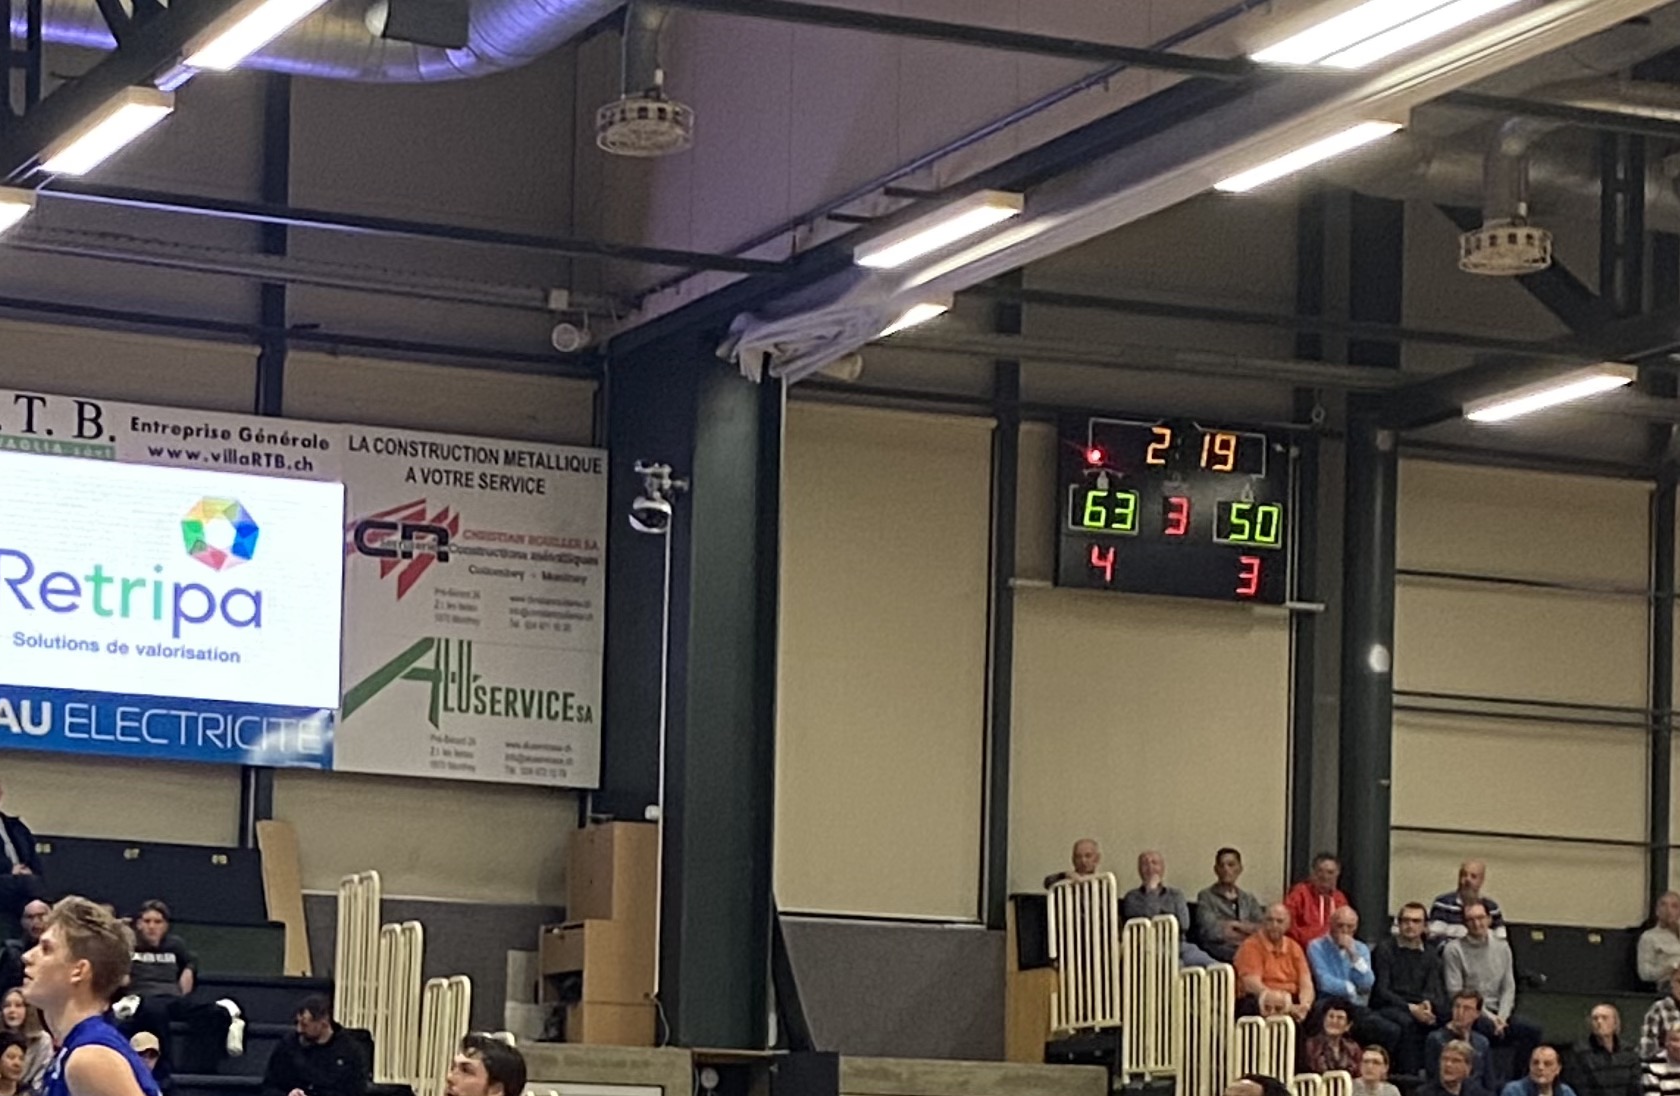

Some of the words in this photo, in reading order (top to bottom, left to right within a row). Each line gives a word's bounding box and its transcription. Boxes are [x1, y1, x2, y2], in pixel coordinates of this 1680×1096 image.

[131, 416, 231, 440] Entreprise
[238, 426, 330, 450] Générale
[1200, 432, 1237, 472] 19
[148, 446, 313, 472] www.villaRTB.ch
[348, 435, 369, 453] LA
[373, 438, 499, 465] CONSTRUCTION
[503, 449, 602, 474] METALLIQUE
[405, 467, 417, 484] A
[420, 467, 474, 489] VOTRE
[478, 472, 546, 495] SERVICE
[1083, 490, 1136, 530] 63
[1164, 496, 1191, 535] 3
[1228, 502, 1280, 542] 50
[1090, 544, 1116, 583] 4
[1235, 556, 1261, 595] 3
[13, 631, 100, 653] Solutions
[106, 640, 130, 655] de
[135, 641, 242, 664] valorisation
[576, 705, 593, 725] SA
